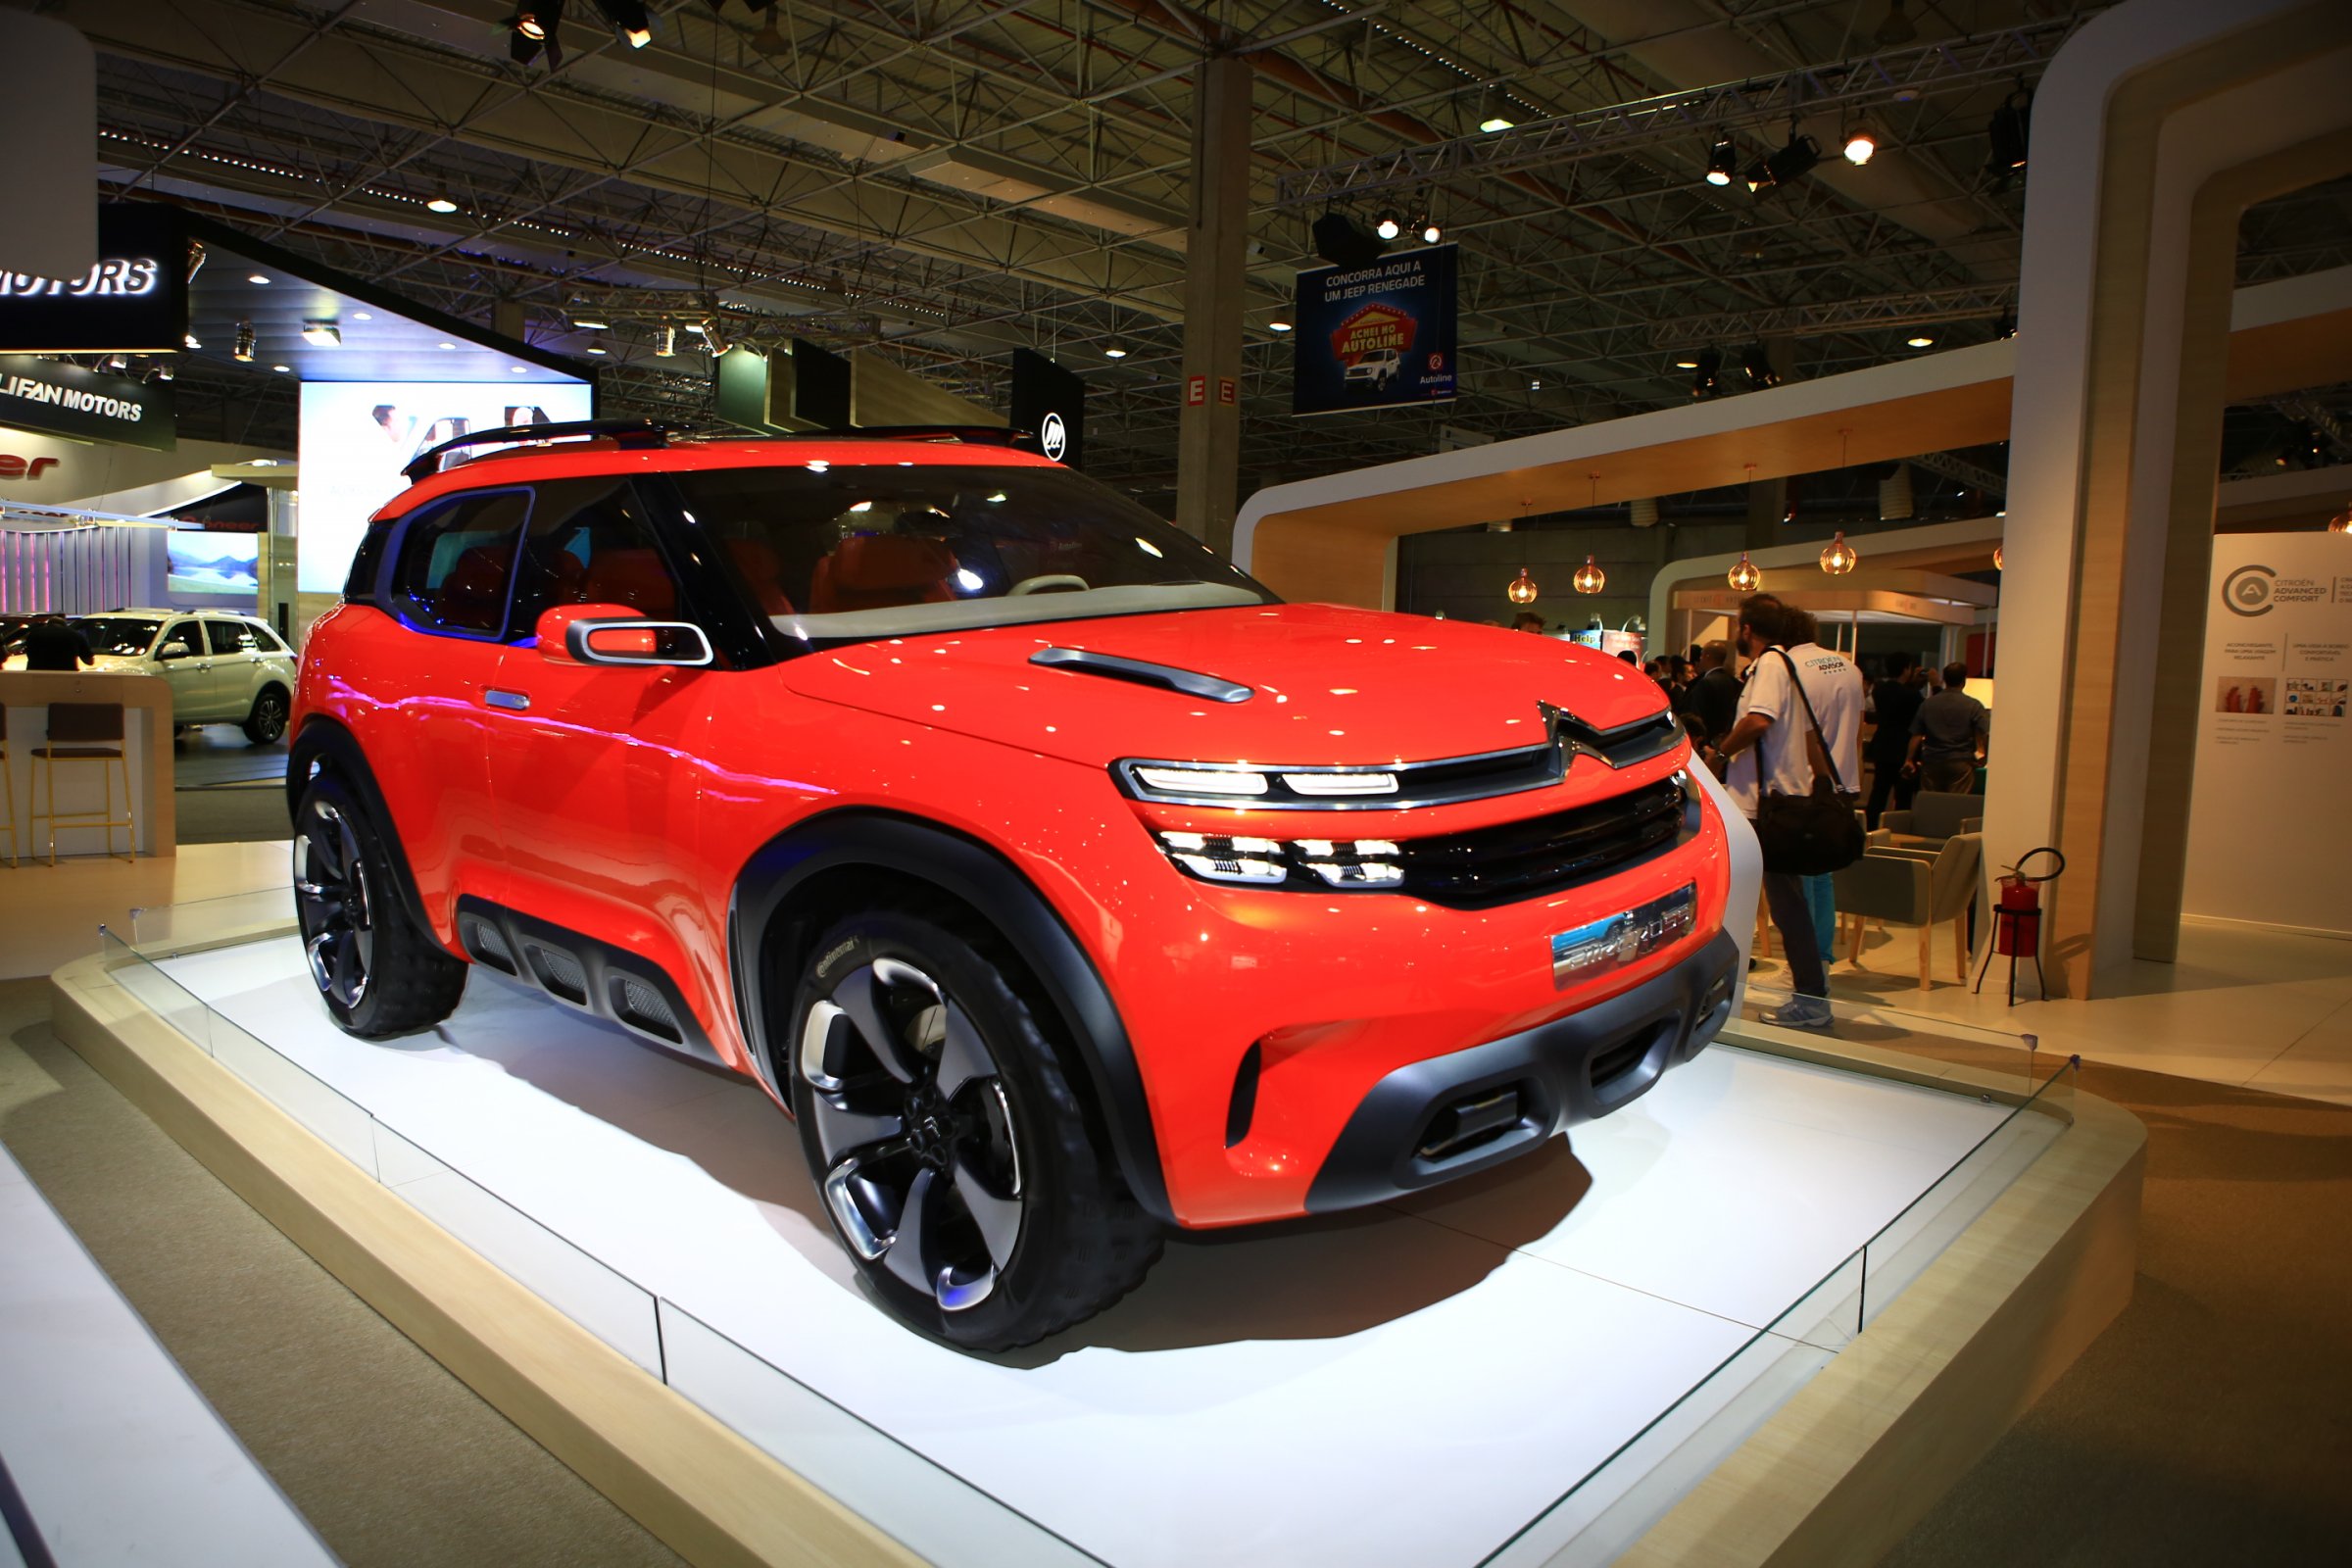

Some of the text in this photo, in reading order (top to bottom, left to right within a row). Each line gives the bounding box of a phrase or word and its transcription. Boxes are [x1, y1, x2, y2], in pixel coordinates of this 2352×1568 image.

[1326, 261, 1421, 287] CONCORRA AQUI A
[1325, 274, 1425, 303] UM JEEP RENEGADE
[1350, 324, 1396, 340] ACHEI NO
[1342, 333, 1404, 354] AUTOLINE
[1420, 373, 1452, 384] Autoline
[0, 373, 142, 422] LIFAN MOTORS
[1190, 379, 1203, 402] E
[1221, 381, 1233, 402] E
[1819, 662, 1844, 671] ADVISOR
